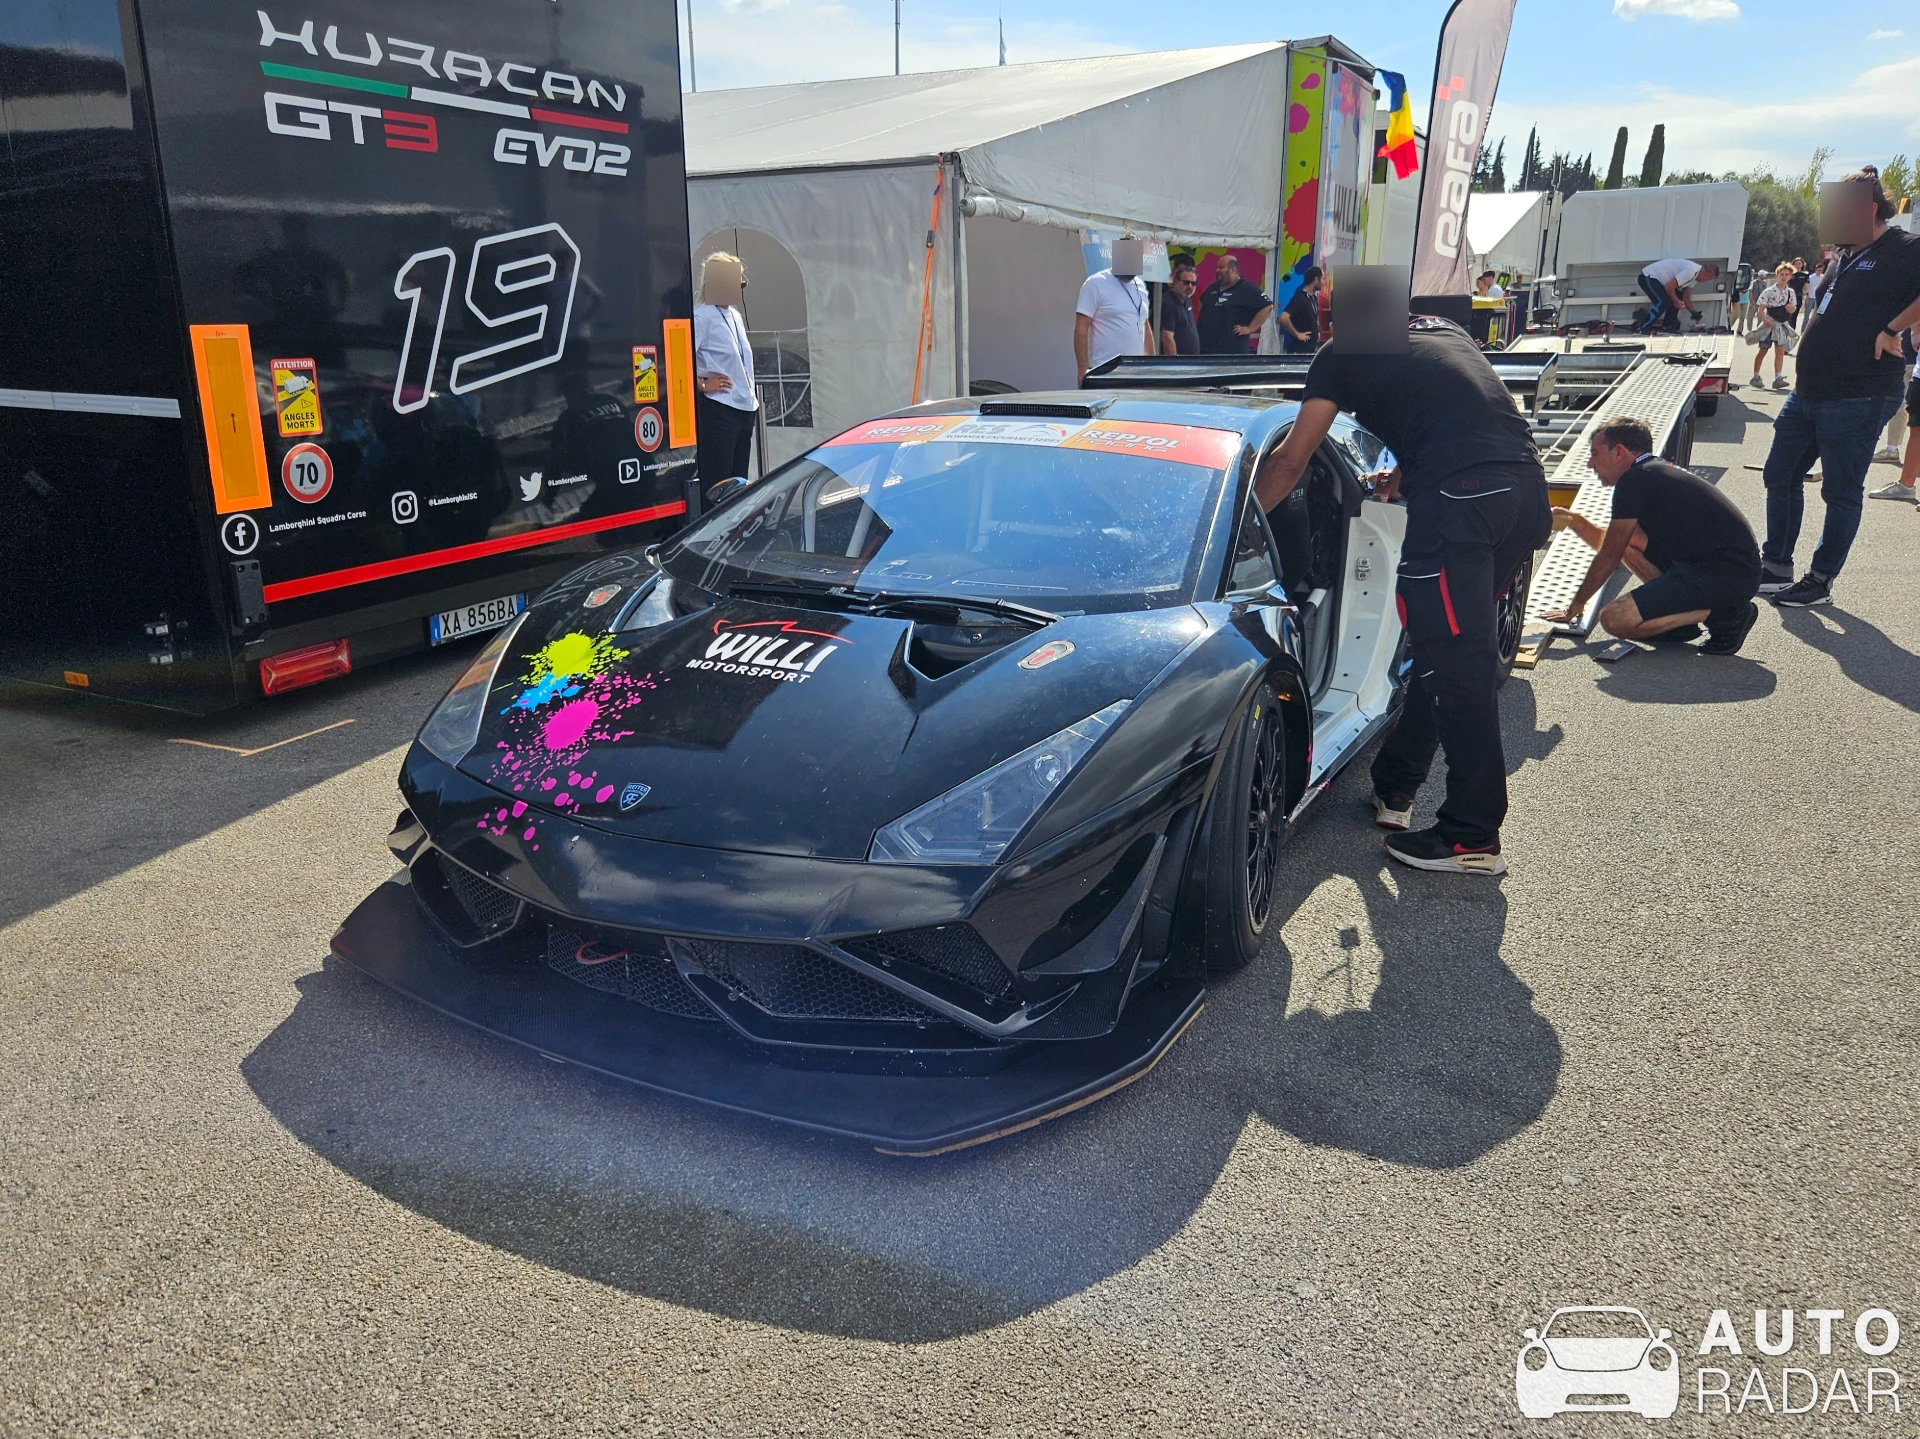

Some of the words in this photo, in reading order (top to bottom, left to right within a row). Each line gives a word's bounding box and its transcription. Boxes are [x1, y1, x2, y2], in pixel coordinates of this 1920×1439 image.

[257, 10, 626, 112] HURACAN
[264, 91, 438, 153] GT3
[494, 127, 631, 177] EVO2
[1333, 183, 1361, 235] WILLI
[1150, 242, 1164, 256] 310
[393, 222, 581, 415] 19
[273, 360, 314, 369] ATTENTION
[284, 411, 315, 422] ANGLES
[286, 420, 315, 430] MORTS
[642, 421, 656, 438] 80
[868, 425, 945, 436] REPSOL
[951, 424, 1011, 435] RES
[1081, 431, 1180, 448] REPSOL
[295, 461, 319, 487] 70
[643, 460, 668, 471] Lamborghini
[428, 492, 478, 507] @LamborghiniSC
[269, 517, 316, 533] Lamborghini
[316, 513, 346, 525] Squadra
[346, 510, 367, 520] Corse
[441, 611, 461, 636] XA
[467, 597, 516, 628] 856BA
[705, 632, 838, 673] WILLI
[685, 659, 811, 684] MOTORSPORT
[628, 784, 648, 792] REITER
